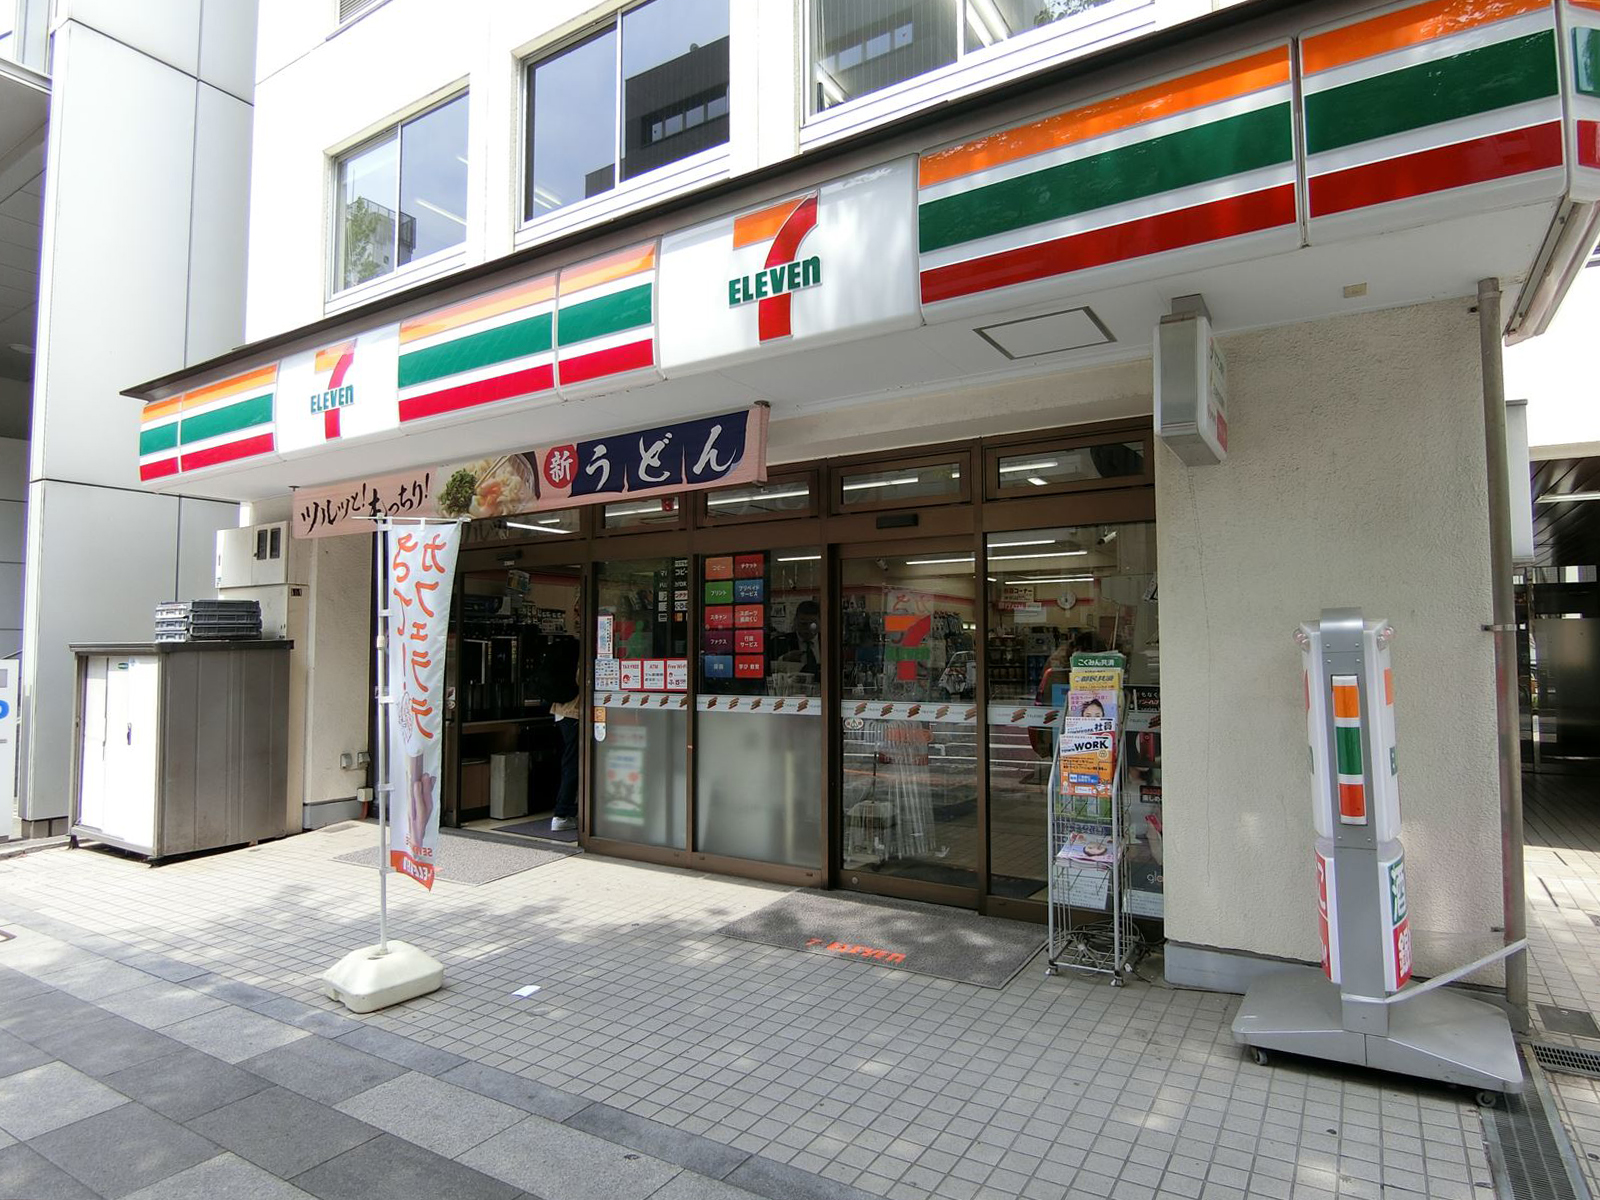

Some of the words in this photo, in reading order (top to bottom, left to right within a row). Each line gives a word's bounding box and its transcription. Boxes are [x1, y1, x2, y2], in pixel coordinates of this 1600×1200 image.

[550, 450, 573, 483] 新
[586, 424, 738, 492] うどん
[1074, 740, 1108, 751] WORK
